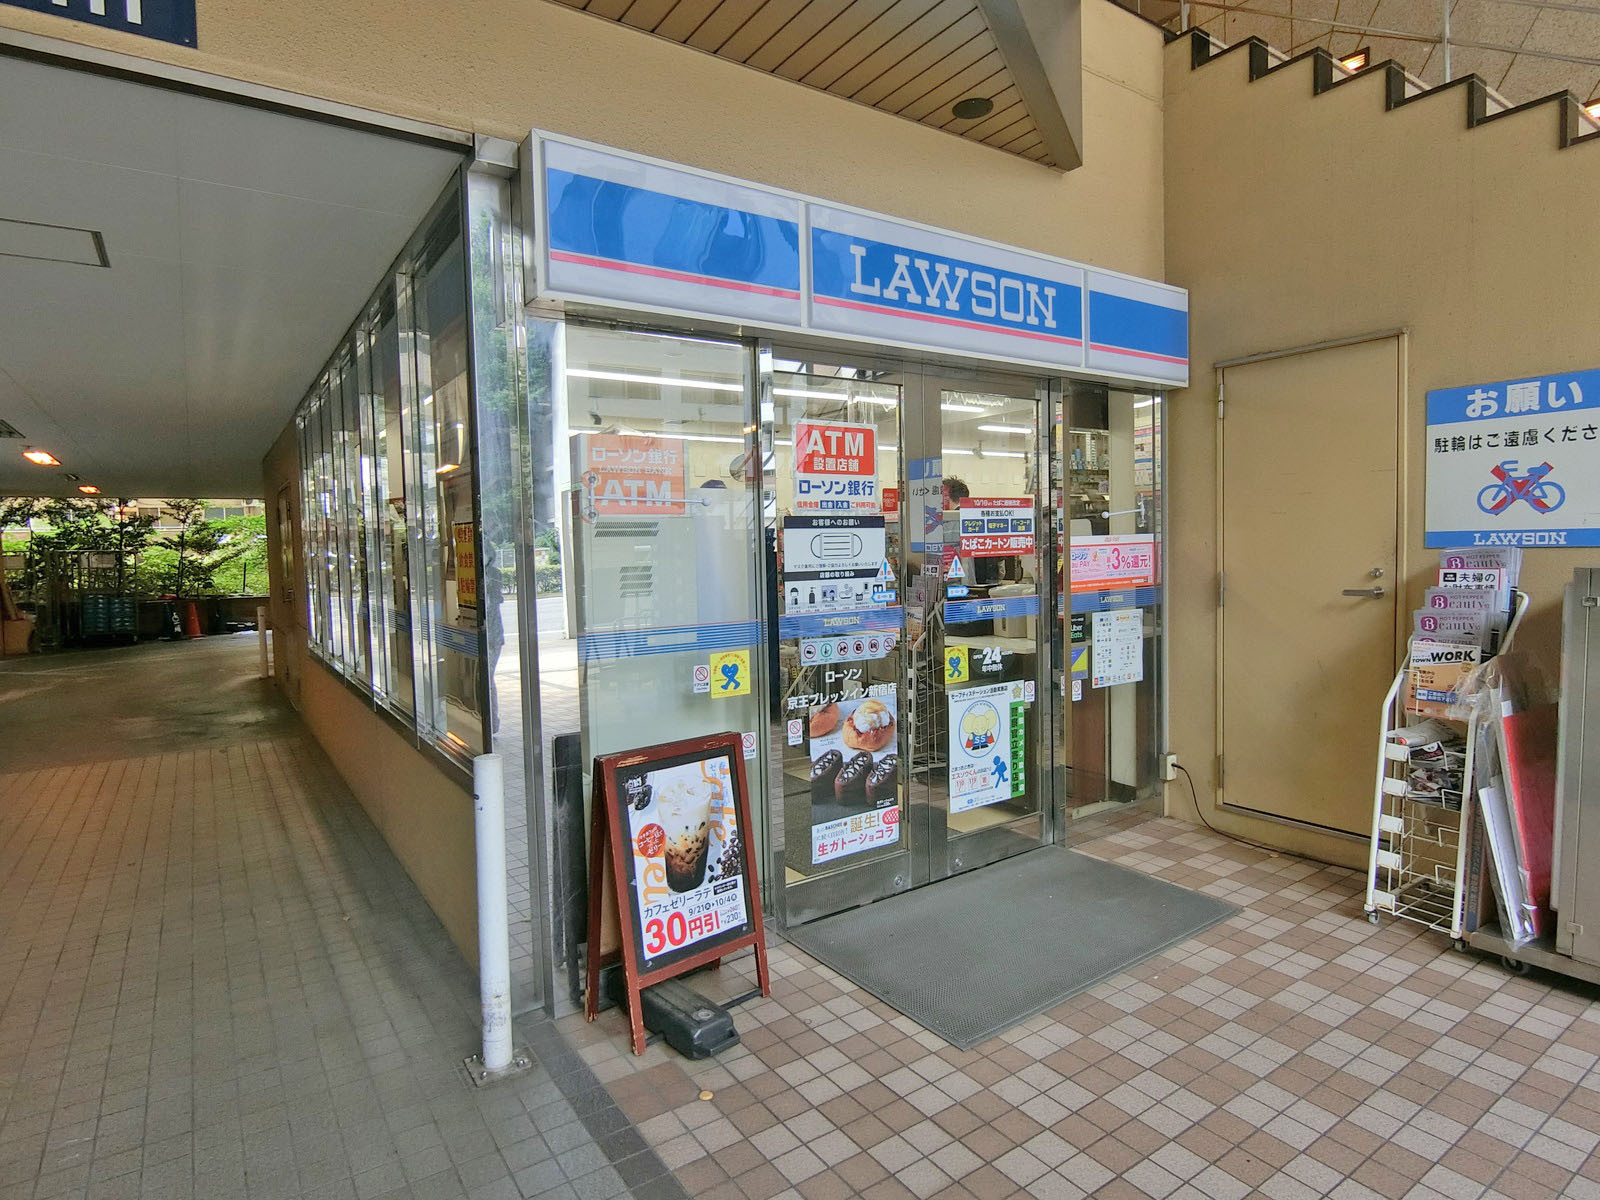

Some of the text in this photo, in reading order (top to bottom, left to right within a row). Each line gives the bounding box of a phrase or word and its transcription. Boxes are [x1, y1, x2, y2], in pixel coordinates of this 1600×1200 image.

[849, 244, 1057, 330] LAWSON
[1465, 381, 1583, 418] お願い
[806, 429, 864, 457] ATM
[1434, 424, 1598, 454] 駐輪はご遠慮くださ
[592, 447, 678, 465] ローソン銀行
[813, 457, 859, 472] 設置店舗
[601, 479, 672, 507] ATM
[798, 480, 874, 496] ローソン銀行
[812, 518, 861, 526] お客様へのお願い
[961, 536, 1033, 550] たばこカートン販売中
[1473, 532, 1567, 545] LAWSON
[1079, 560, 1091, 568] PAY
[1111, 547, 1151, 570] 3%還元!
[1459, 573, 1496, 583] 夫婦の
[977, 603, 1006, 613] LAWSON
[824, 616, 860, 627] LAWSON
[982, 646, 1001, 665] 24
[1430, 650, 1476, 662] WORK
[825, 668, 862, 683] ローソン
[787, 683, 897, 710] 京王プレッソイン新宿店
[974, 735, 986, 744] SS
[849, 812, 880, 833] 誕生!
[817, 825, 894, 857] 生ガトーショコラ
[643, 887, 711, 919] カフェゼリーラテ
[645, 910, 721, 954] 30円引
